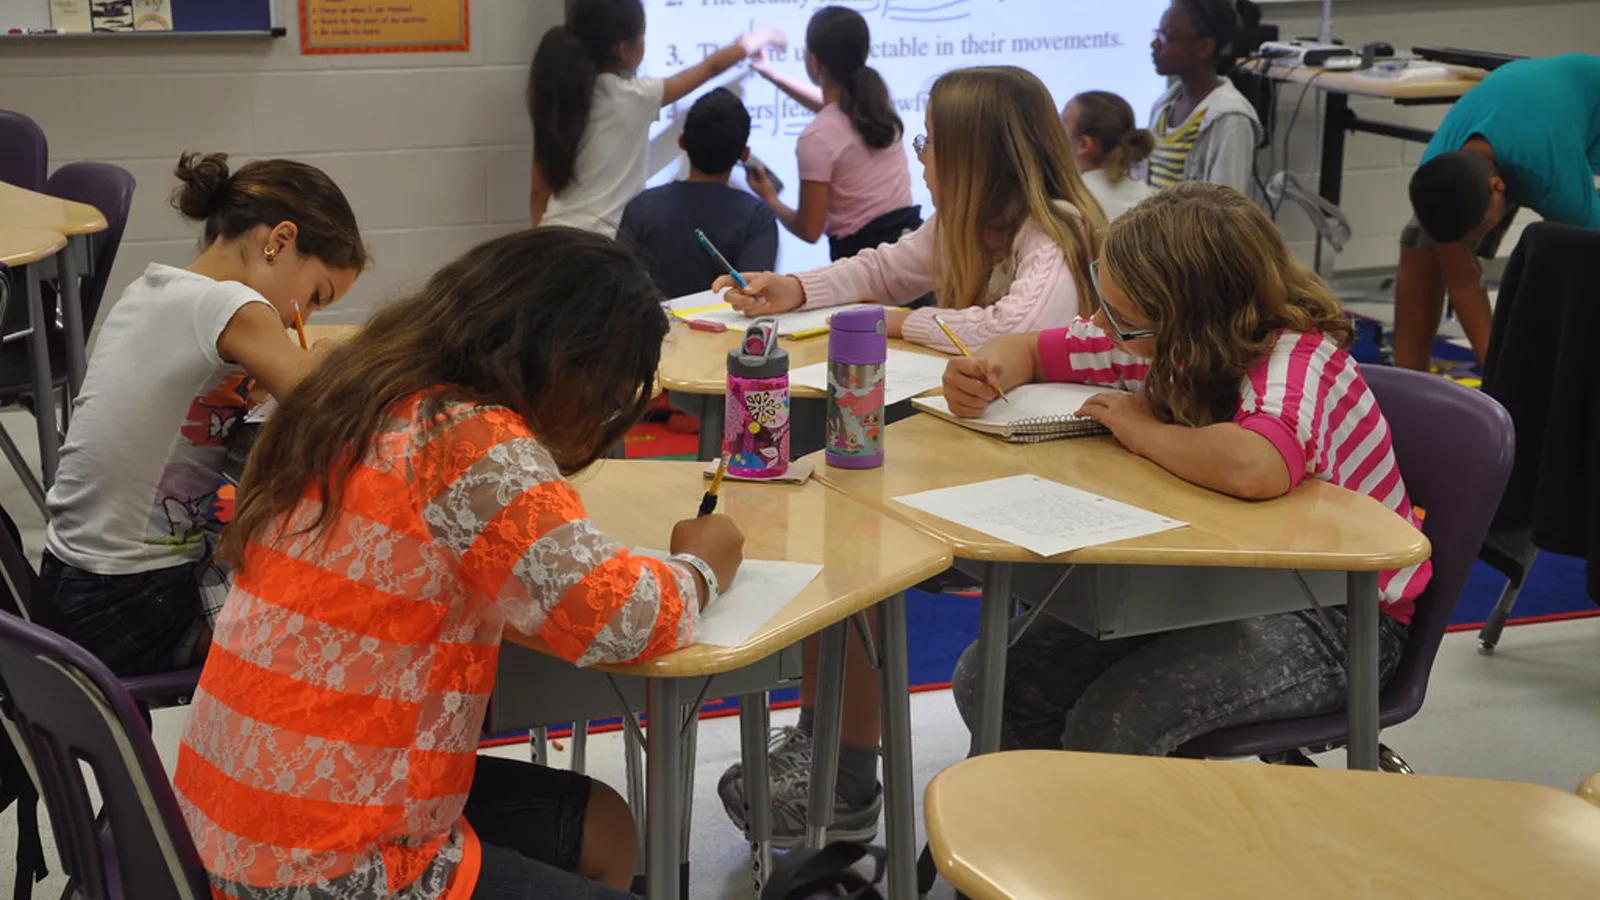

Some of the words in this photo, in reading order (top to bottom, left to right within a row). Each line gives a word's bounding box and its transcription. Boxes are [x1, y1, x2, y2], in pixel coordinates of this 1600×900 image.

[665, 44, 684, 67] 3.
[936, 35, 954, 56] in
[961, 32, 1006, 56] their
[1011, 31, 1124, 53] movements.
